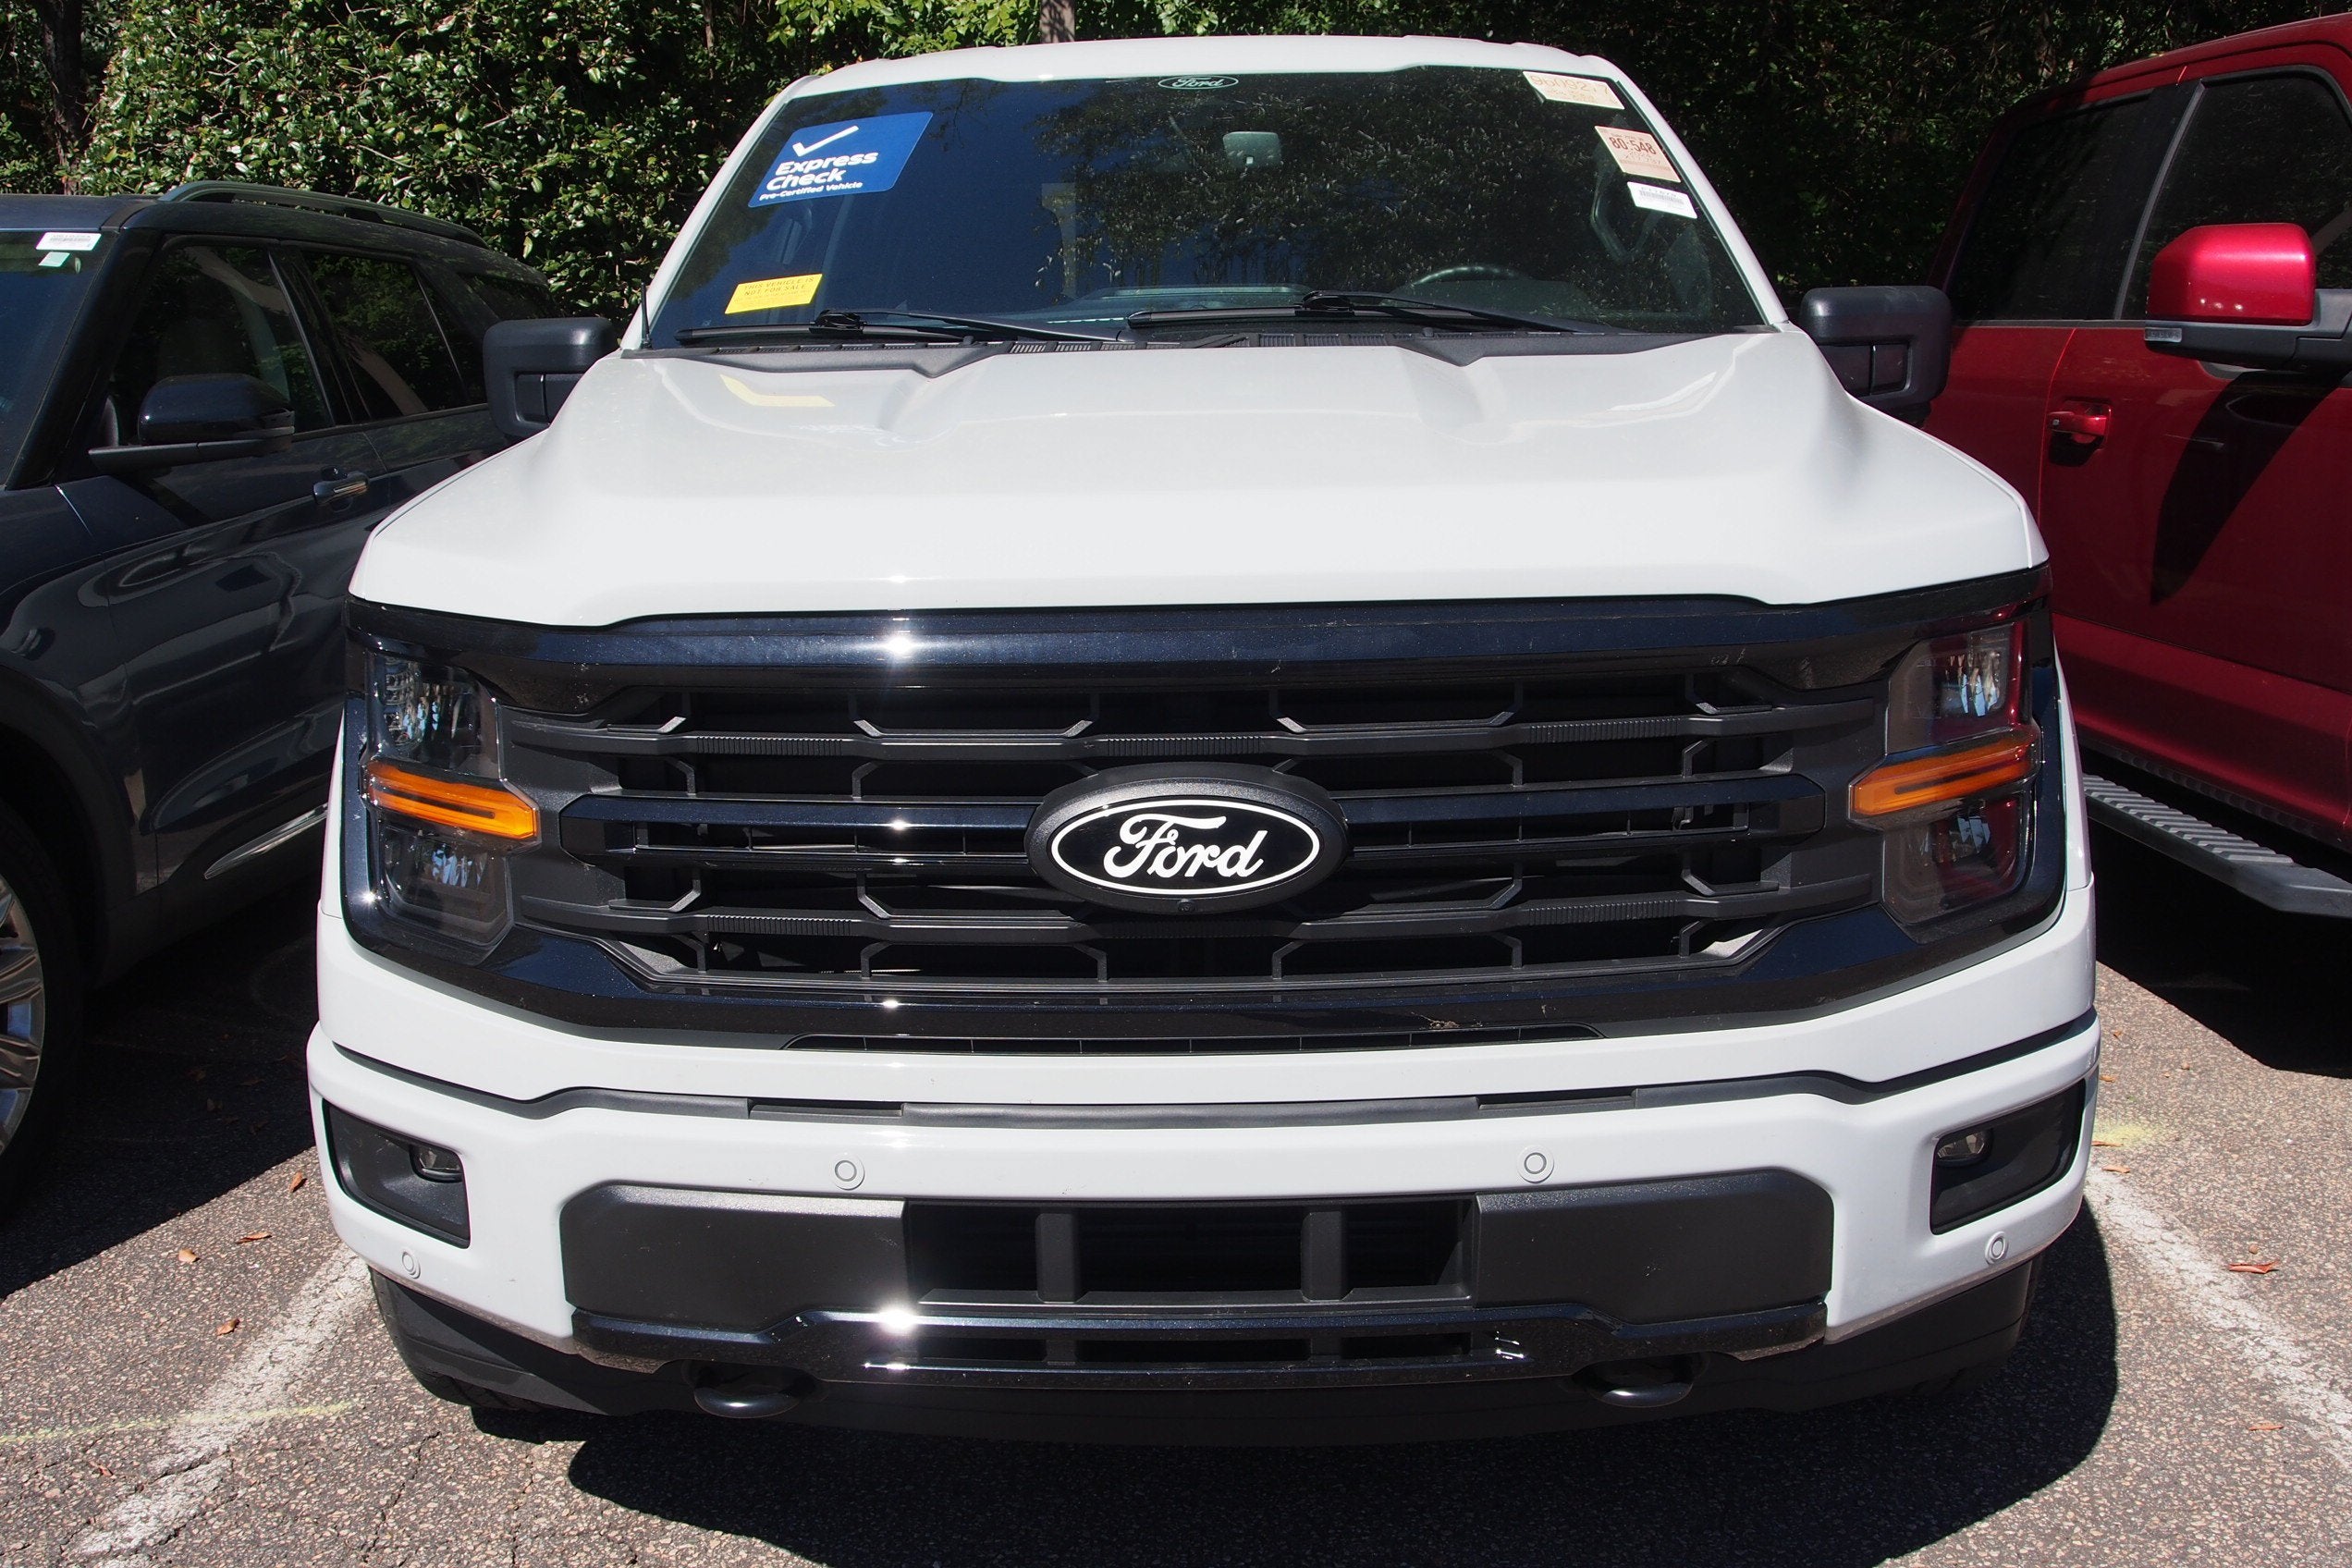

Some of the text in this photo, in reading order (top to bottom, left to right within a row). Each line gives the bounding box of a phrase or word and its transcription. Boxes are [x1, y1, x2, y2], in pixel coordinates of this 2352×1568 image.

[1172, 77, 1224, 88] Ford
[775, 152, 879, 176] Express
[766, 167, 847, 191] Check
[759, 181, 864, 202] Pre-Certified Vehicle
[1103, 813, 1268, 878] Ford
